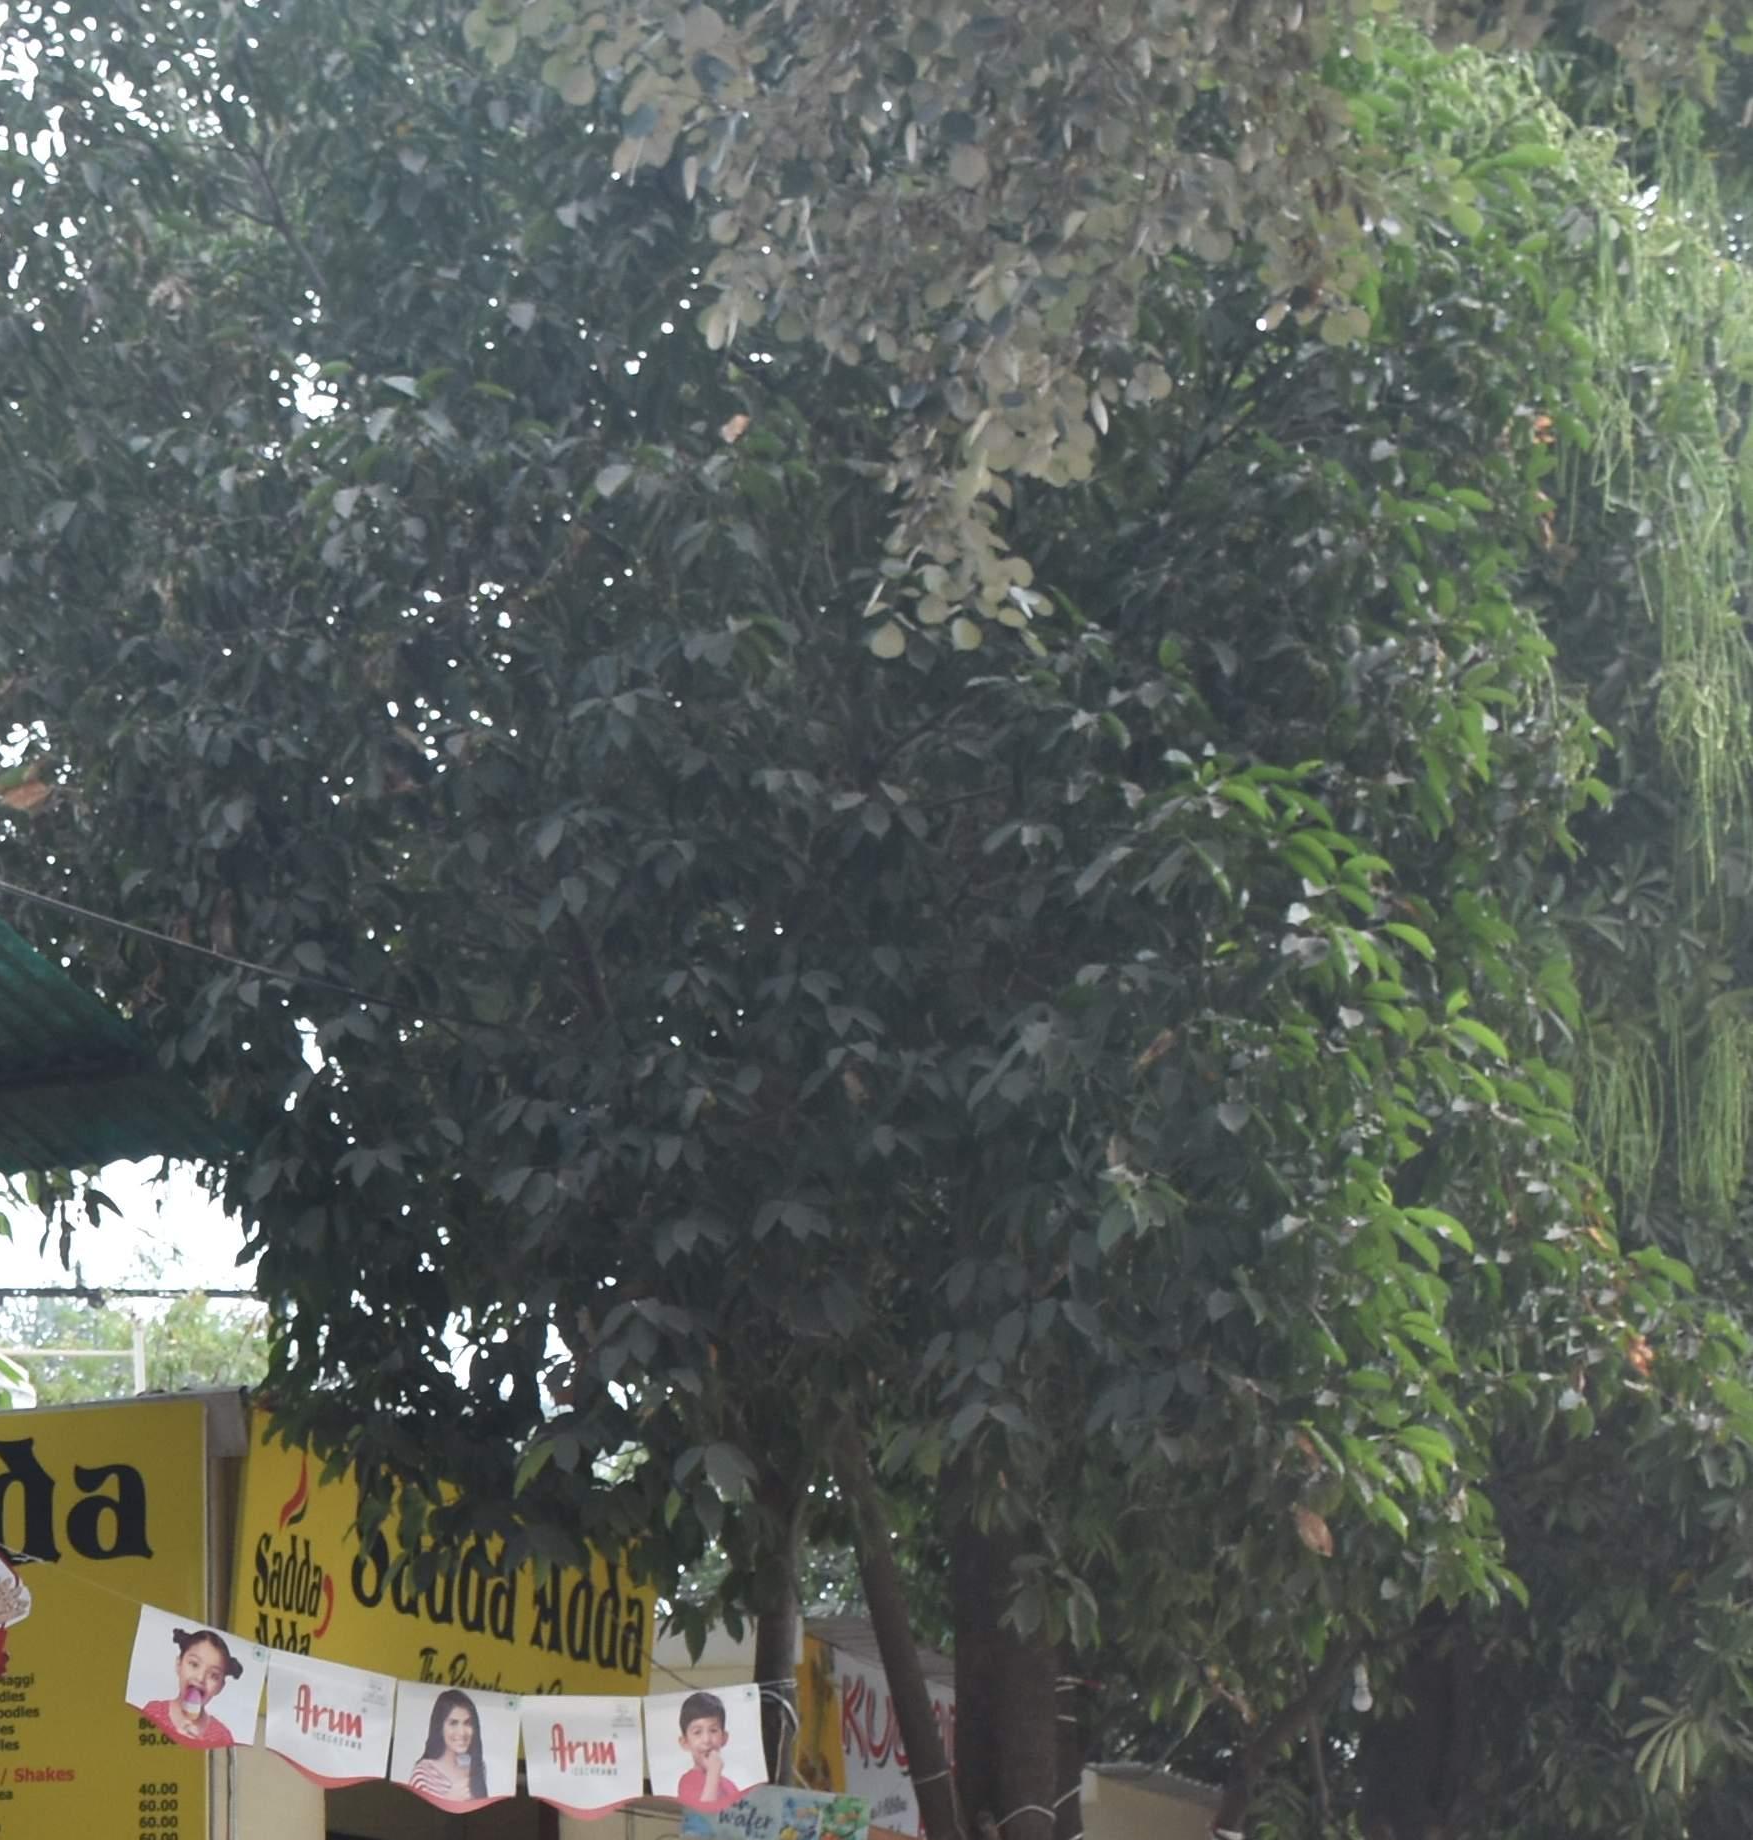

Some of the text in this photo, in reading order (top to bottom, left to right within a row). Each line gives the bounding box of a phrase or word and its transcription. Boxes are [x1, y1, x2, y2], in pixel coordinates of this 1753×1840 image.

[253, 1533, 322, 1618] Sadda
[294, 1684, 362, 1738] Arun
[550, 1723, 616, 1772] Arun
[14, 1767, 75, 1783] Shakes
[139, 1783, 178, 1795] 40.00
[139, 1800, 178, 1812] 60.00
[139, 1817, 178, 1829] 60.00
[719, 1807, 773, 1837] wafer
